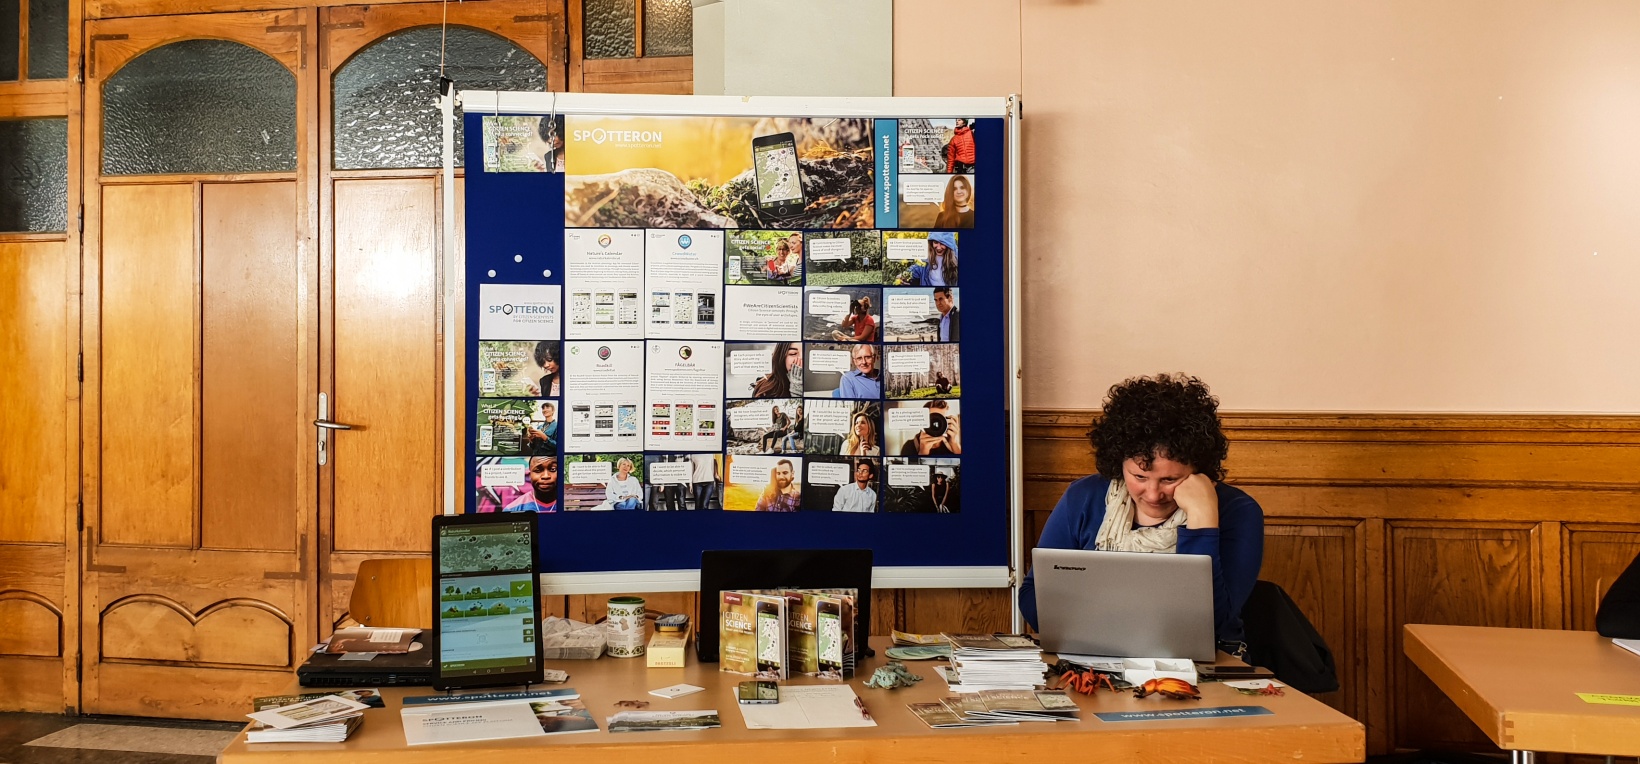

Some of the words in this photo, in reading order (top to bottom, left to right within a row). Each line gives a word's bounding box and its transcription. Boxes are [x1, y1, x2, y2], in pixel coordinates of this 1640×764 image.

[573, 128, 662, 145] SPOTTERON
[489, 303, 554, 315] SPOTTERON
[725, 611, 748, 621] CITIZEN
[725, 619, 752, 630] SCIENCE
[427, 691, 552, 701] www.spotteron.net
[1120, 707, 1246, 718] www.spotteron.net
